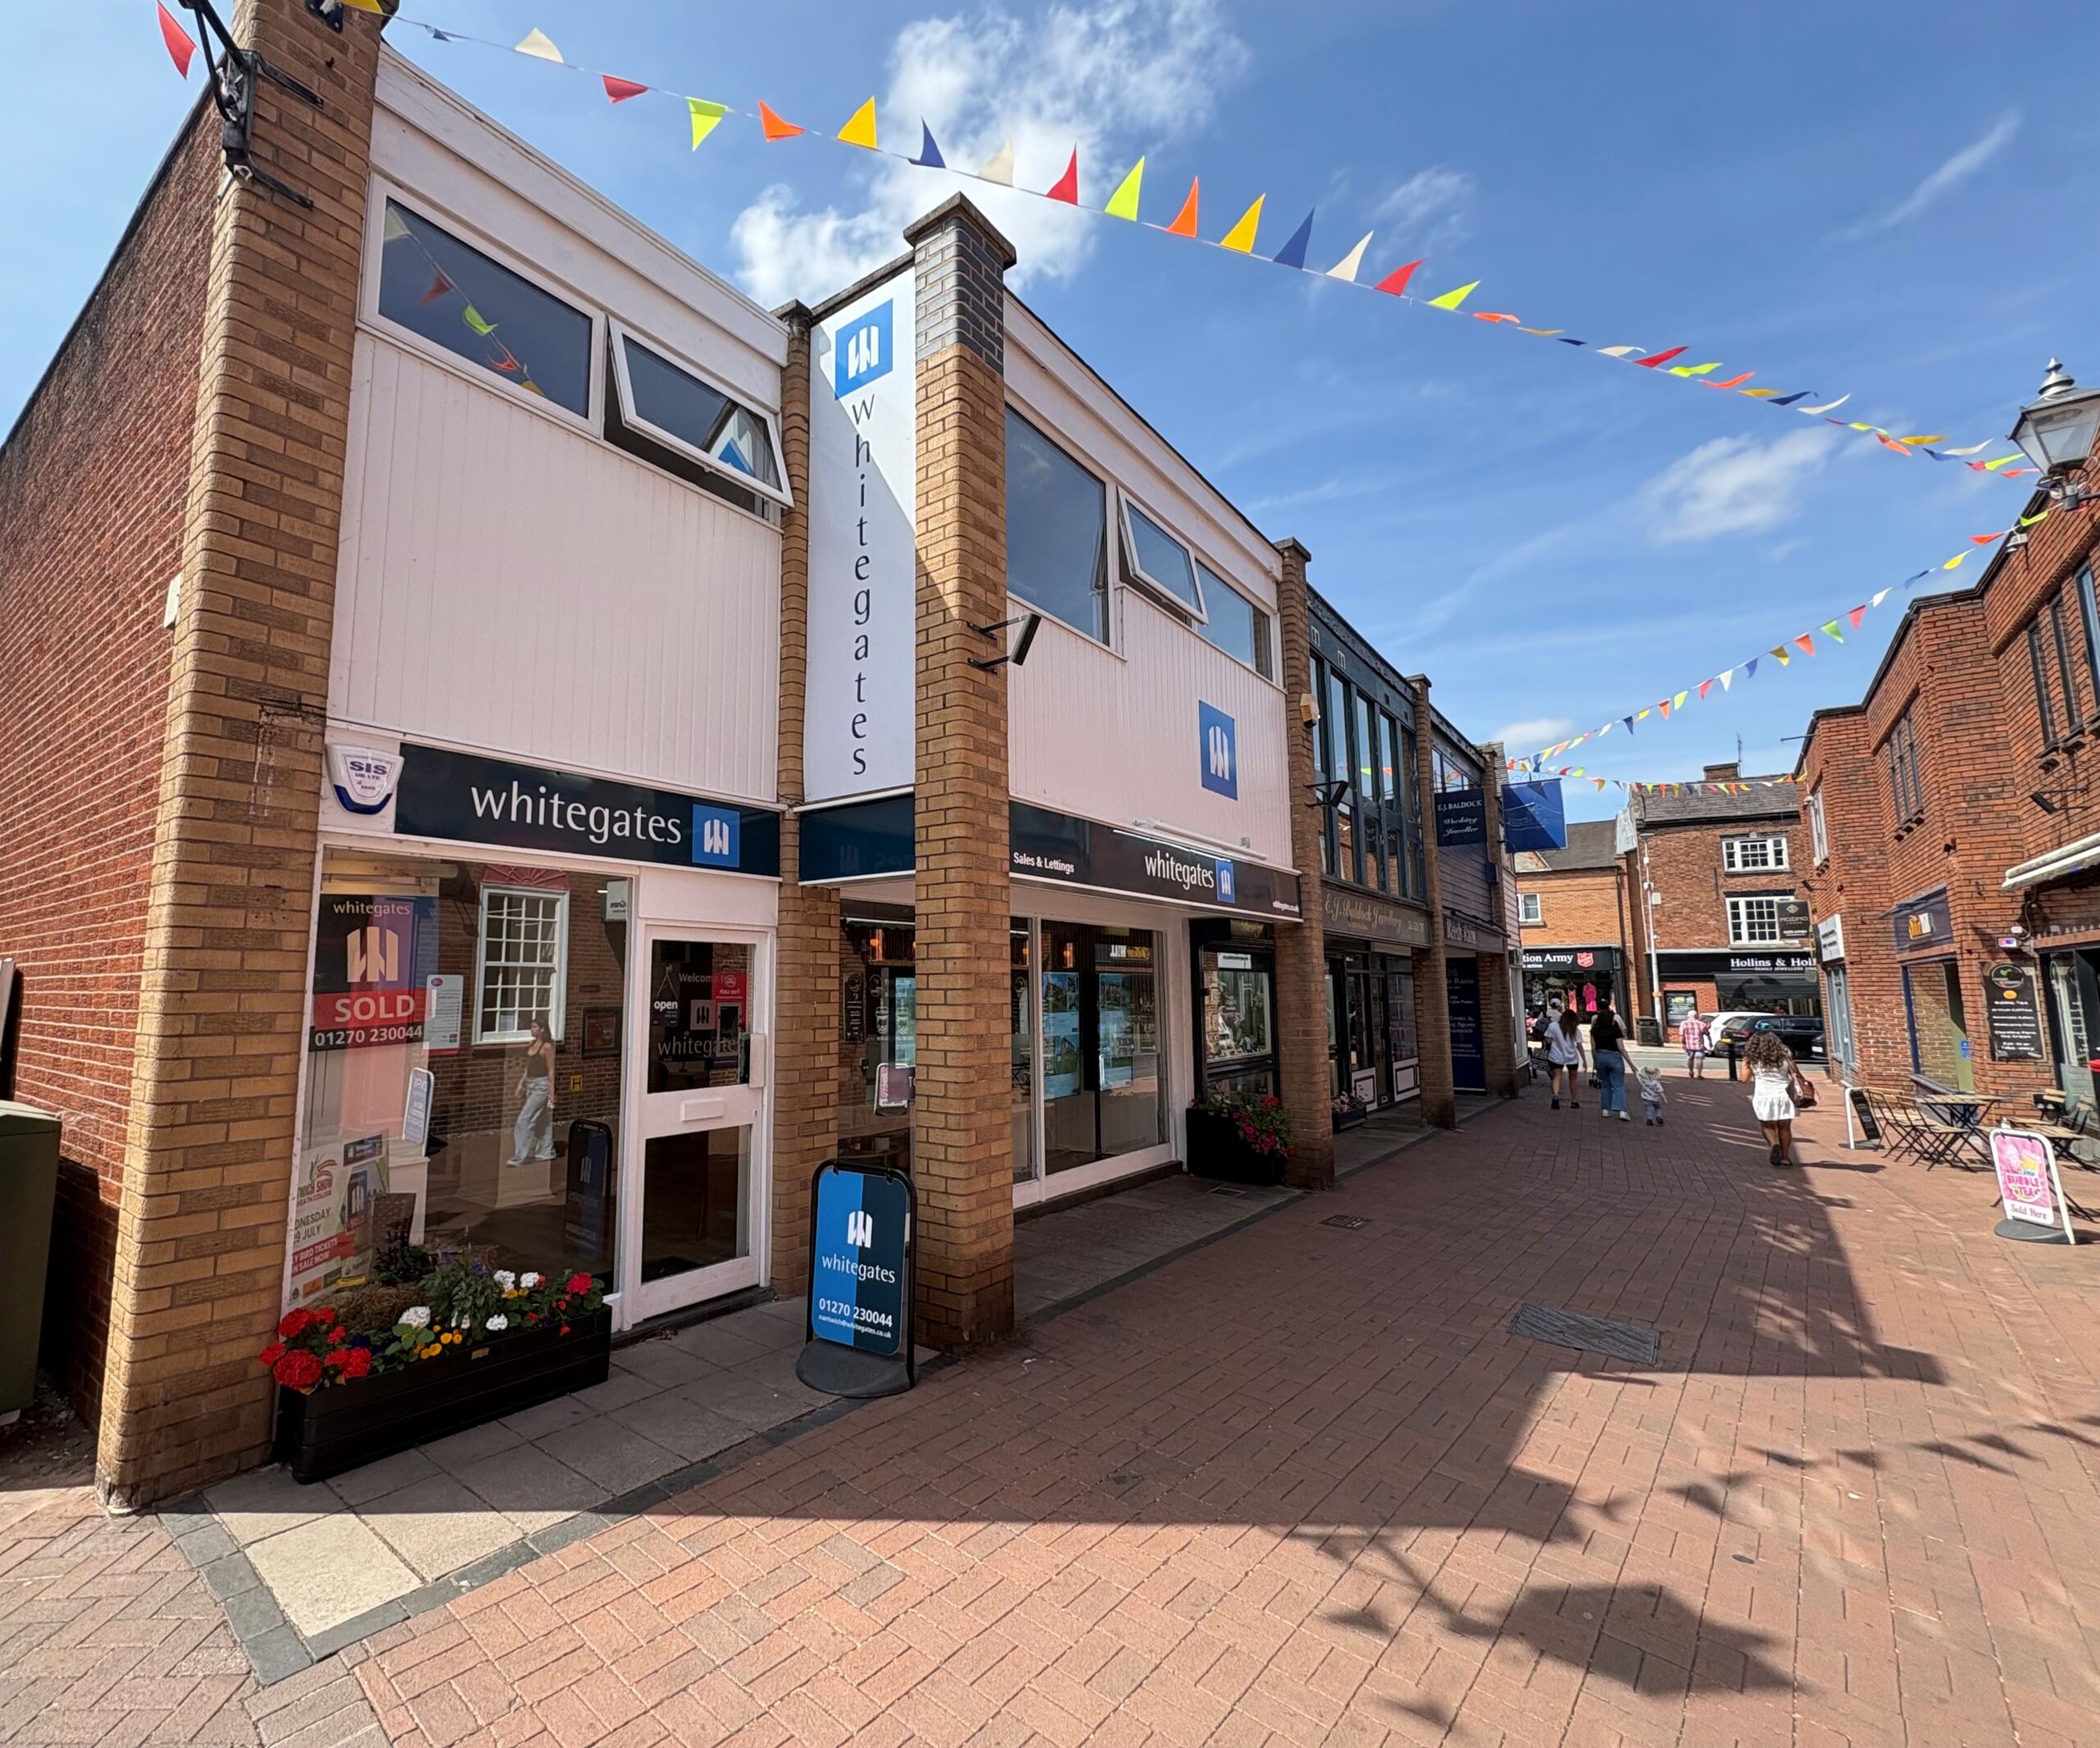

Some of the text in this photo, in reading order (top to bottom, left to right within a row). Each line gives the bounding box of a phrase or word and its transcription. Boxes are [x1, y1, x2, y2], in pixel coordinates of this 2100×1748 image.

[851, 393, 876, 776] whitegates
[349, 760, 388, 775] SIS
[471, 781, 682, 844] whitegates
[1448, 800, 1482, 810] BALDOCK
[1013, 852, 1075, 874] Sales & Lettings
[1144, 849, 1215, 890] whitegates
[333, 900, 410, 917] whitegates
[1544, 953, 1573, 964] Army
[1731, 957, 1772, 967] Hollins
[1775, 957, 1787, 967] &
[678, 973, 719, 984] Welcome
[335, 994, 415, 1023] SOLD
[654, 1001, 678, 1012] open
[314, 1025, 423, 1047] 01270 230044
[2006, 1175, 2039, 1187] BUBBLE
[2020, 1186, 2034, 1197] TEA
[303, 1224, 321, 1240] JULY
[299, 1248, 314, 1261] BIRD
[314, 1237, 338, 1253] TICKETS
[822, 1253, 896, 1284] whitegates
[819, 1298, 892, 1328] 01270 230044
